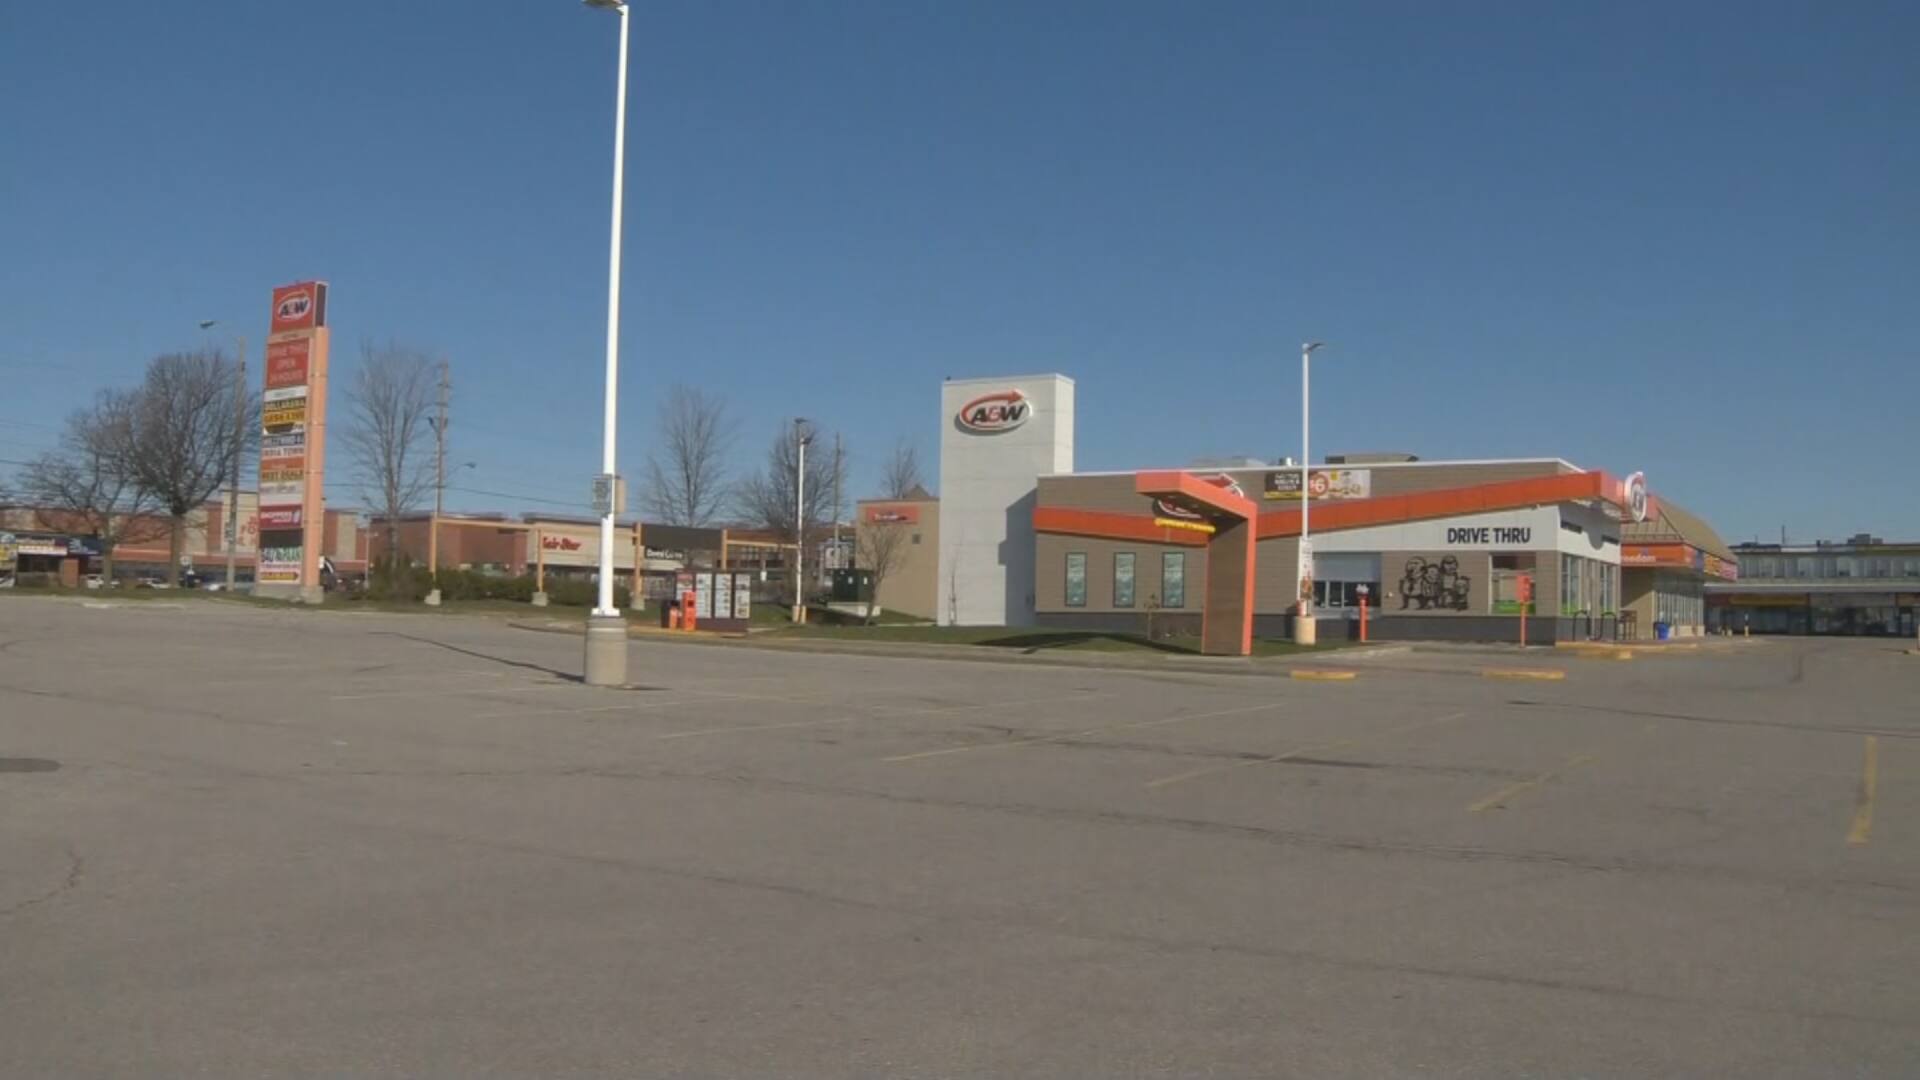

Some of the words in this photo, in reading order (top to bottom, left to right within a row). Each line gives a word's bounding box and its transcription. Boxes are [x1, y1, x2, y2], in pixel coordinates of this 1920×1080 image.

[280, 301, 309, 315] A&W
[971, 405, 1025, 425] A&W
[1447, 527, 1489, 544] DRIVE
[1493, 527, 1531, 544] THRU
